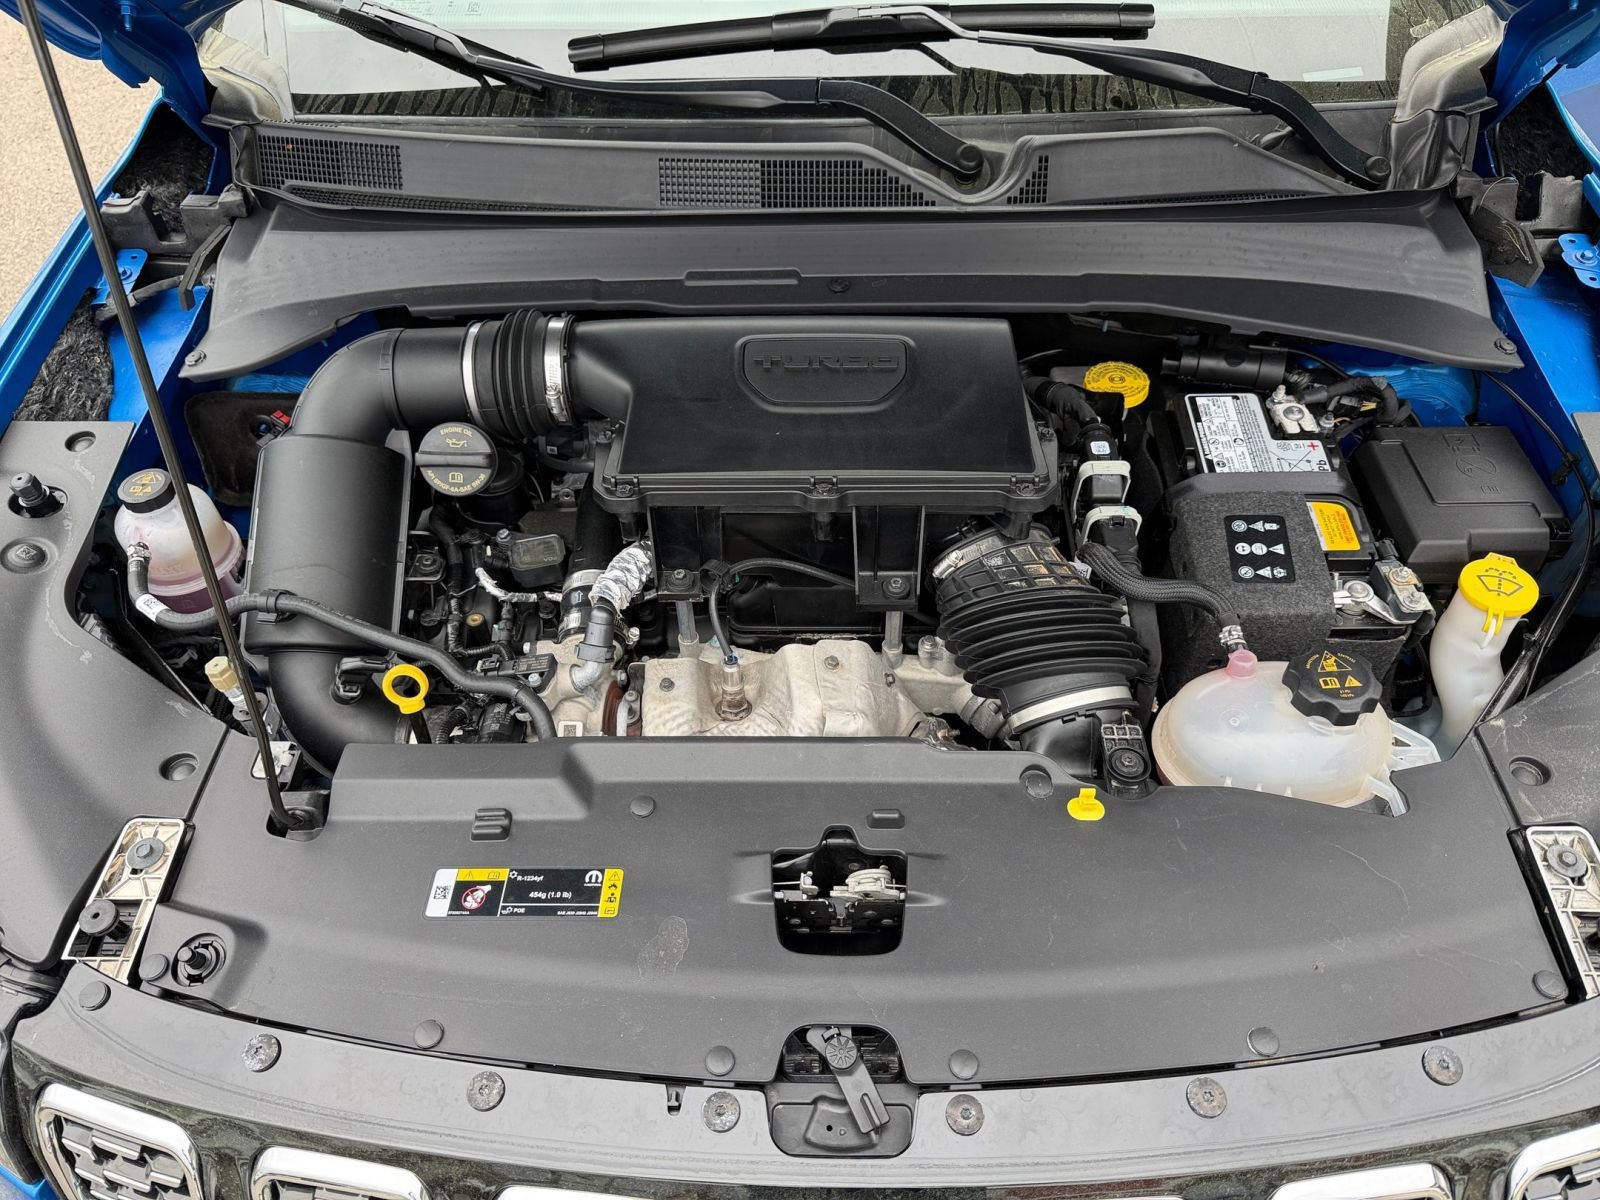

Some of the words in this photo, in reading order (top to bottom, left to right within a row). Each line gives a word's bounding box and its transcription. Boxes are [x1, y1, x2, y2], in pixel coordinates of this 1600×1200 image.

[752, 355, 899, 371] TURBO
[440, 427, 463, 436] ENGINE
[463, 428, 473, 437] OIL
[529, 891, 546, 899] 454g
[547, 891, 561, 899] (1.0
[562, 891, 572, 899] lb)
